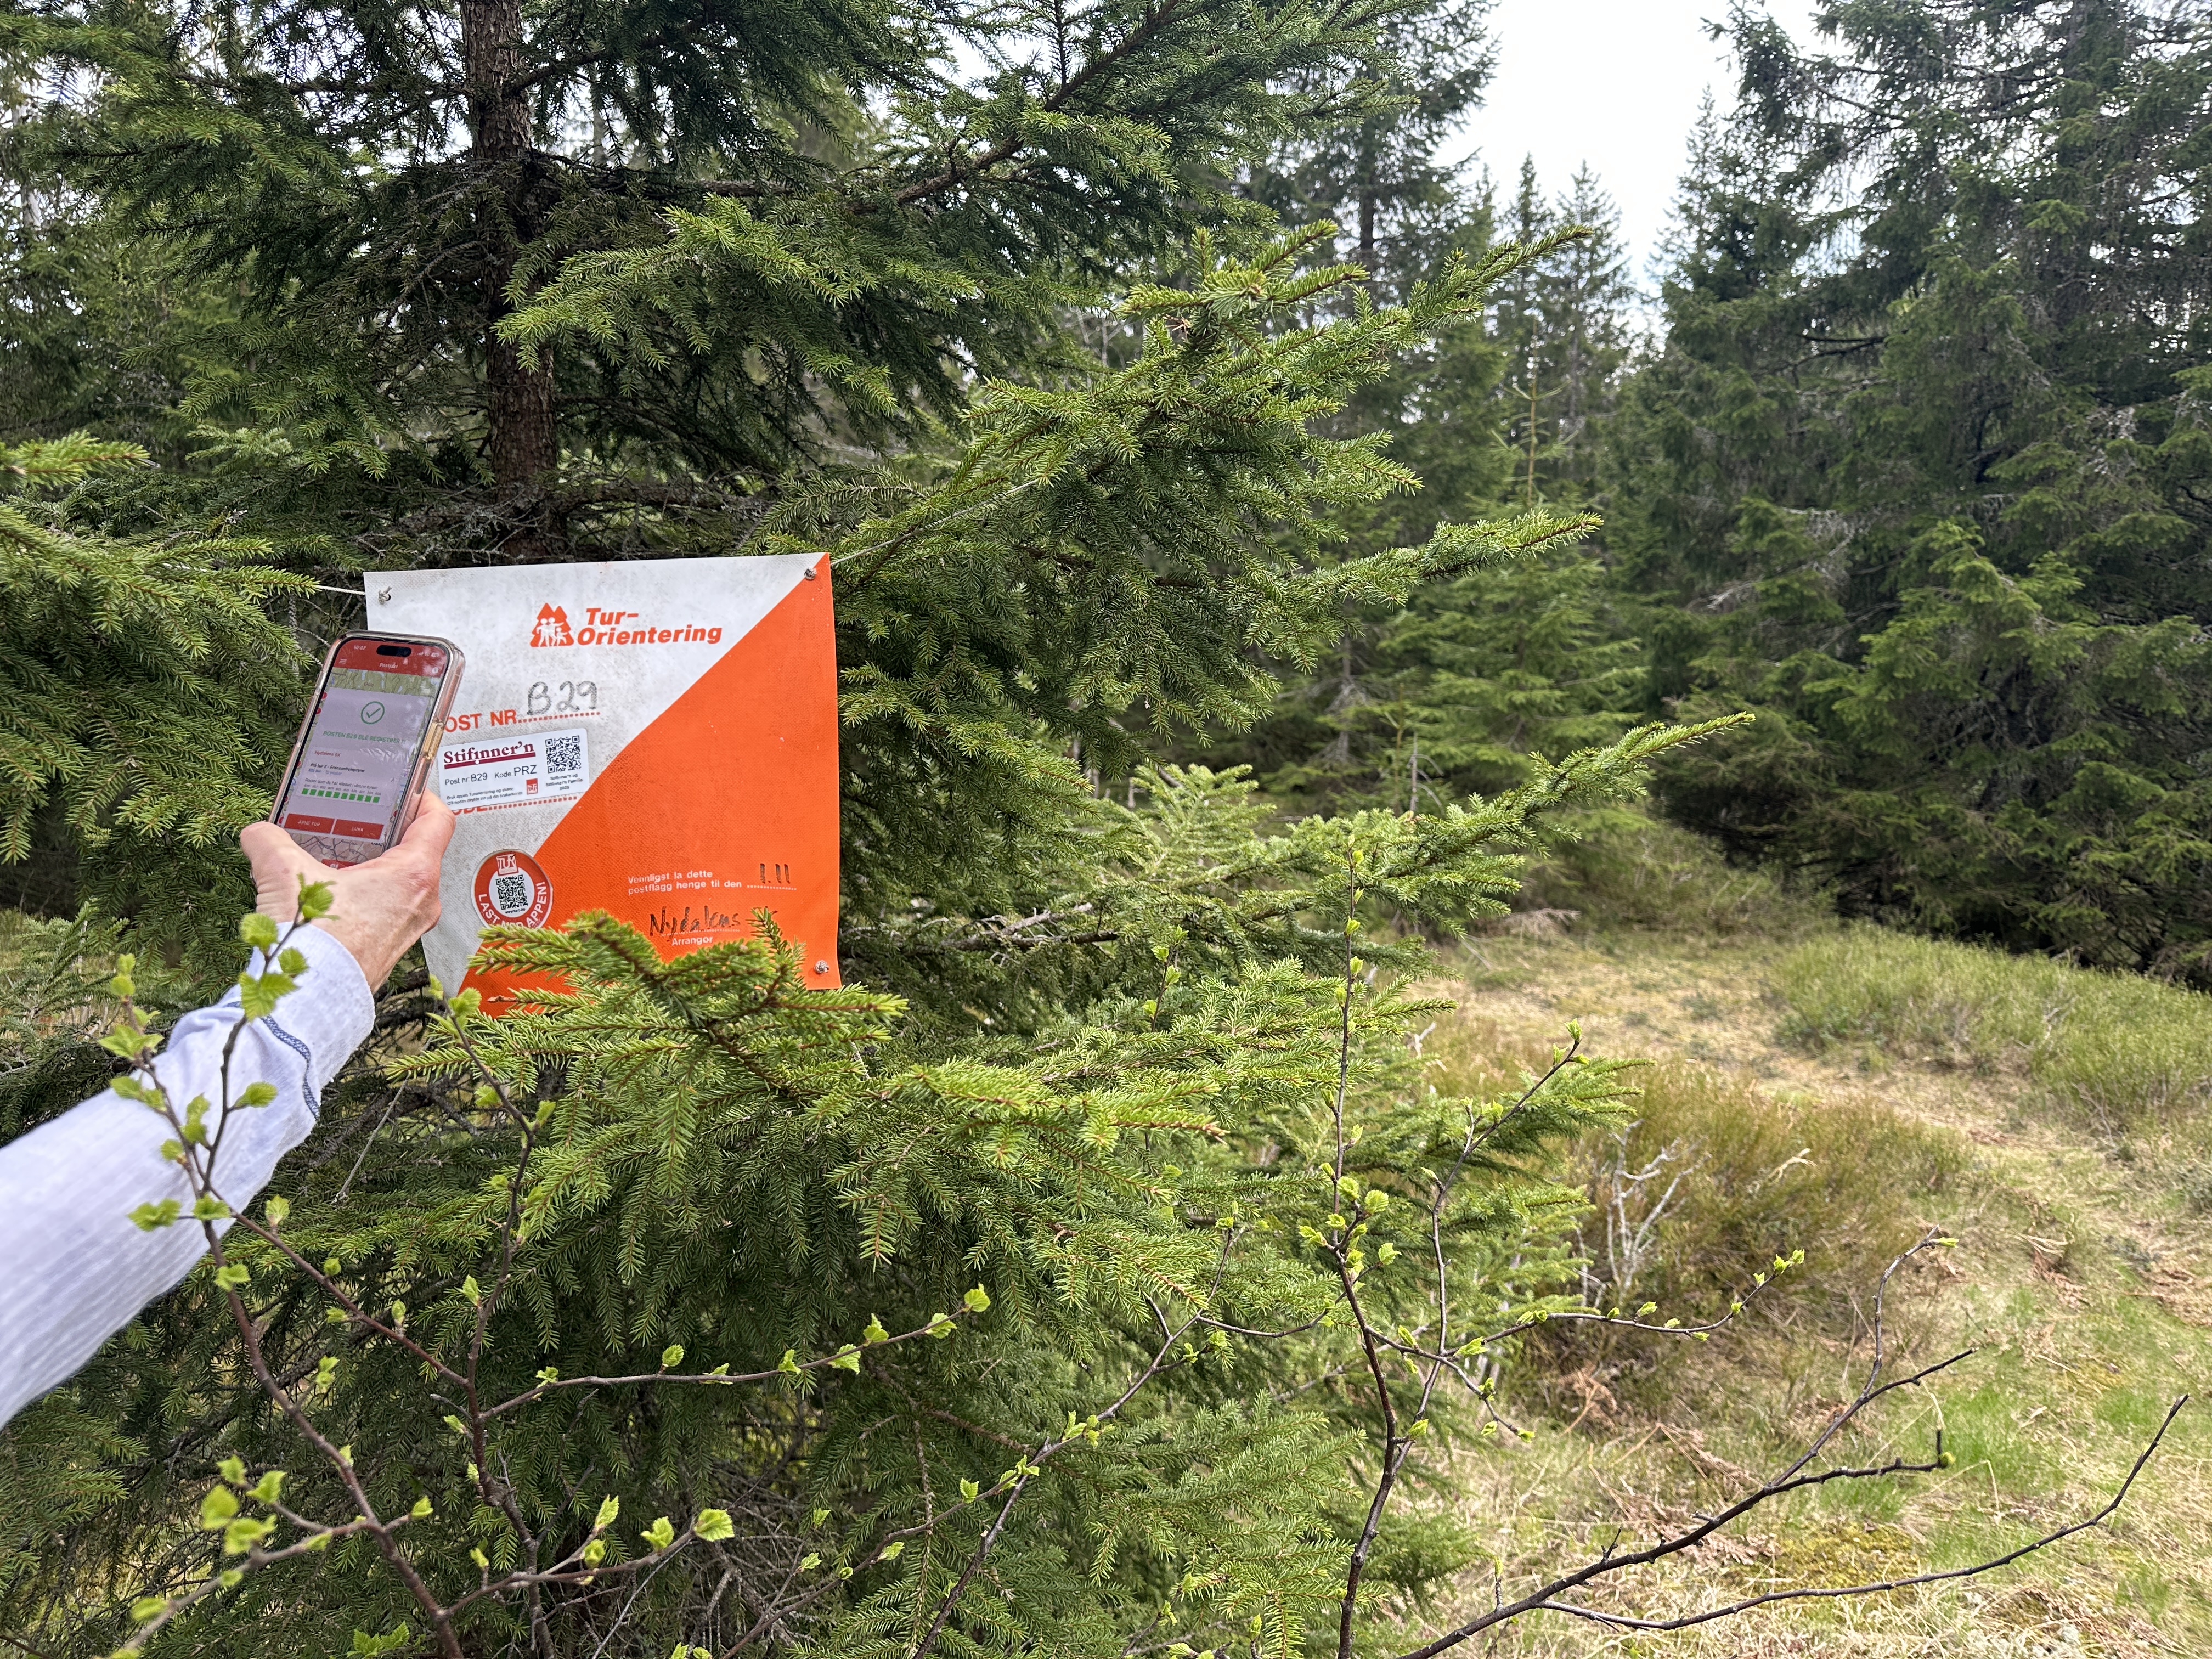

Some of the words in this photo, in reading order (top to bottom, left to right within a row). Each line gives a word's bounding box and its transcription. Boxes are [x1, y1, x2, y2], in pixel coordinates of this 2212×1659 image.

[586, 608, 639, 625] Tur-
[577, 624, 723, 645] Orientering
[527, 681, 597, 715] B29
[445, 713, 482, 733] OST
[444, 741, 534, 764] Stifinner'n
[471, 772, 488, 782] B29
[514, 765, 537, 776] PRZ
[628, 873, 670, 884] Vennligst
[676, 881, 706, 889] henge
[712, 879, 720, 888] til
[478, 894, 500, 924] LAST
[526, 882, 547, 928] APPEN!
[650, 906, 741, 942] Nydalens
